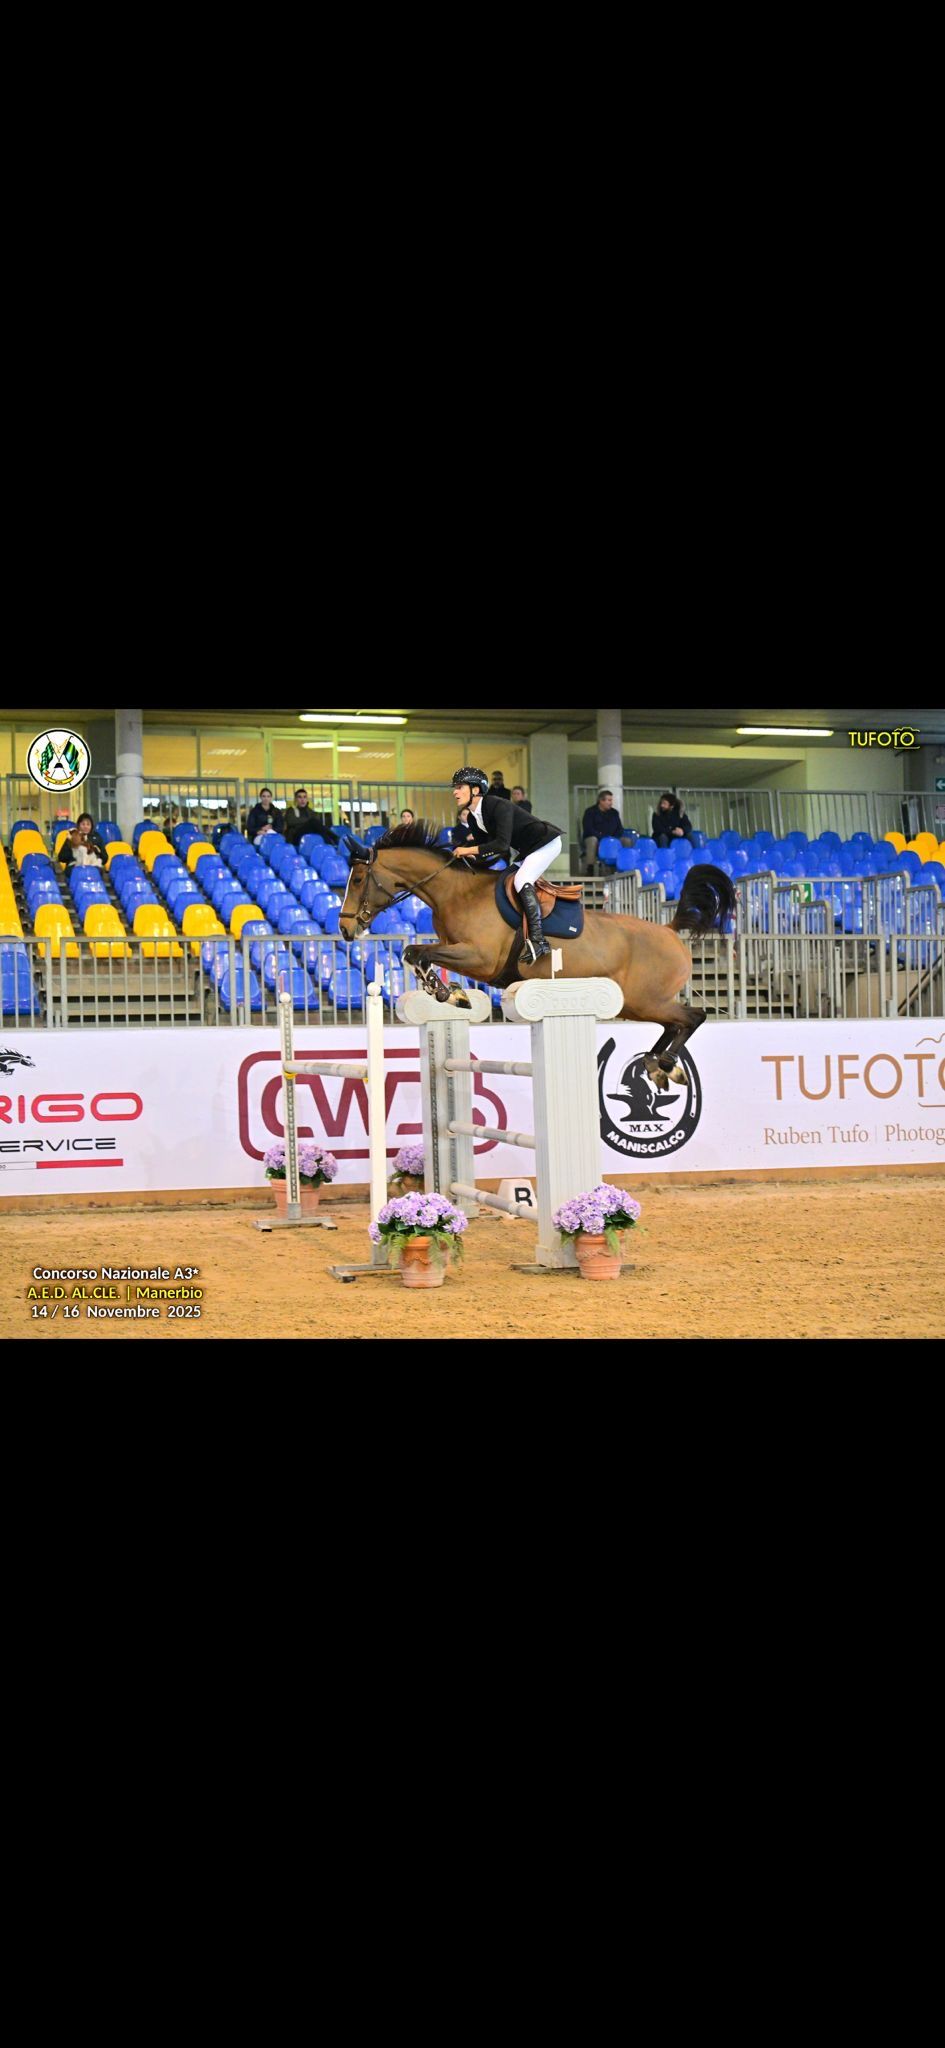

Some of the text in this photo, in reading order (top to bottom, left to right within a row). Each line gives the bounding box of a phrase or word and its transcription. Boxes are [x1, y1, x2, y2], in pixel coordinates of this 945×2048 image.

[761, 1053, 945, 1100] TUFOT
[0, 1092, 143, 1123] IGO
[629, 1124, 664, 1132] MAX
[764, 1127, 822, 1145] Ruben
[827, 1124, 869, 1143] Tufo
[607, 1130, 685, 1153] MANISCALCO
